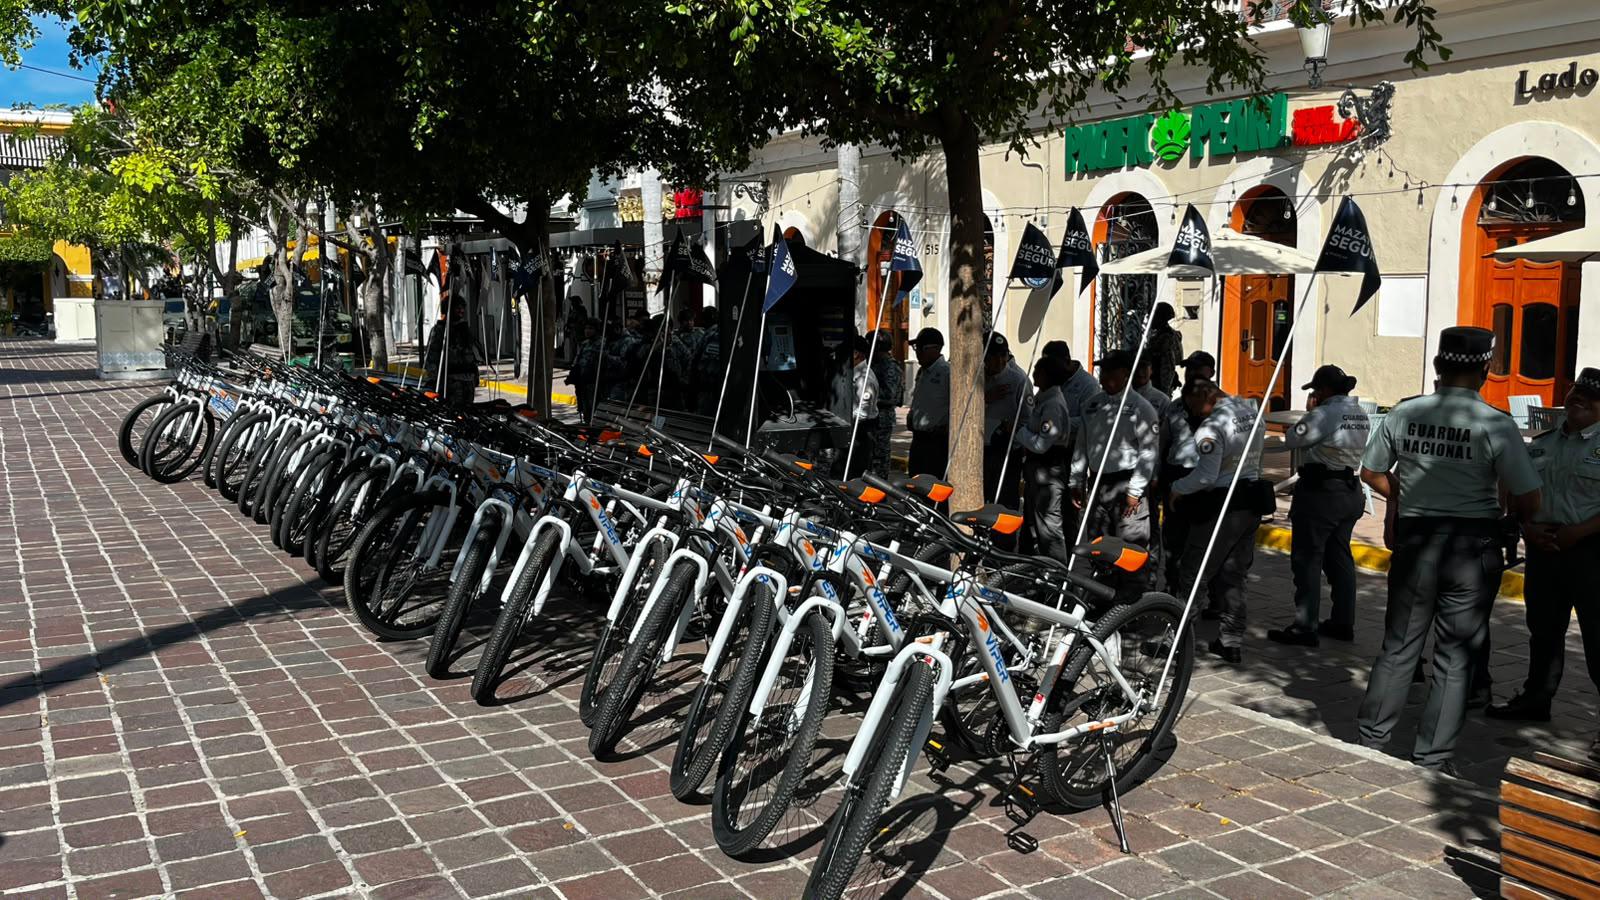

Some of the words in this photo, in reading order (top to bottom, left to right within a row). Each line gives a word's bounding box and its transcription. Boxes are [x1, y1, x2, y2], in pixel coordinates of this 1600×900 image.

[1518, 61, 1599, 95] Lado
[925, 244, 940, 256] 515
[1402, 439, 1473, 460] NACIONAL
[1407, 422, 1471, 443] GUARDIA
[598, 510, 619, 545] VIPER
[872, 587, 899, 632] VIPER
[985, 631, 1009, 684] VIPER
